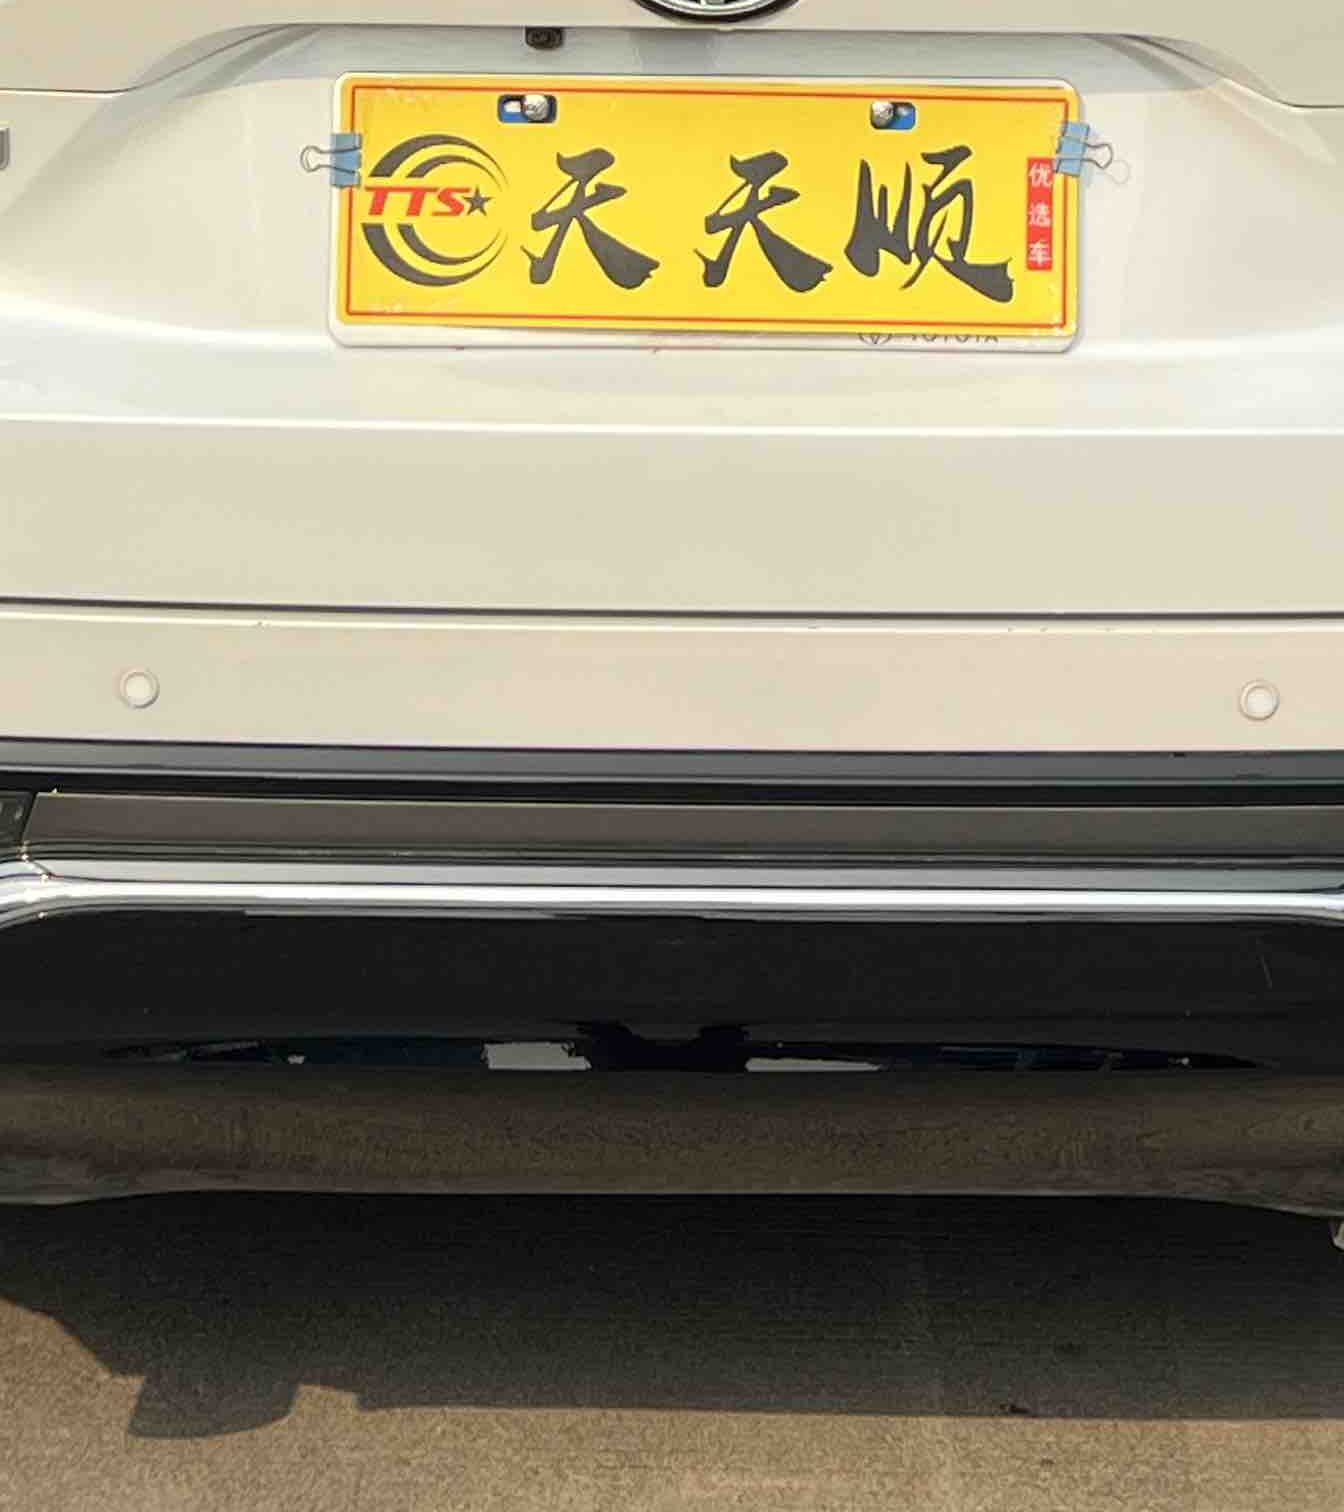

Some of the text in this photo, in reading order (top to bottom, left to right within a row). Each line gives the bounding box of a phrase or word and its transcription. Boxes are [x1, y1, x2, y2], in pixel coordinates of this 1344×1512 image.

[362, 183, 471, 217] TTS
[520, 143, 1014, 303] 天天顺
[1027, 160, 1054, 268] 优选车
